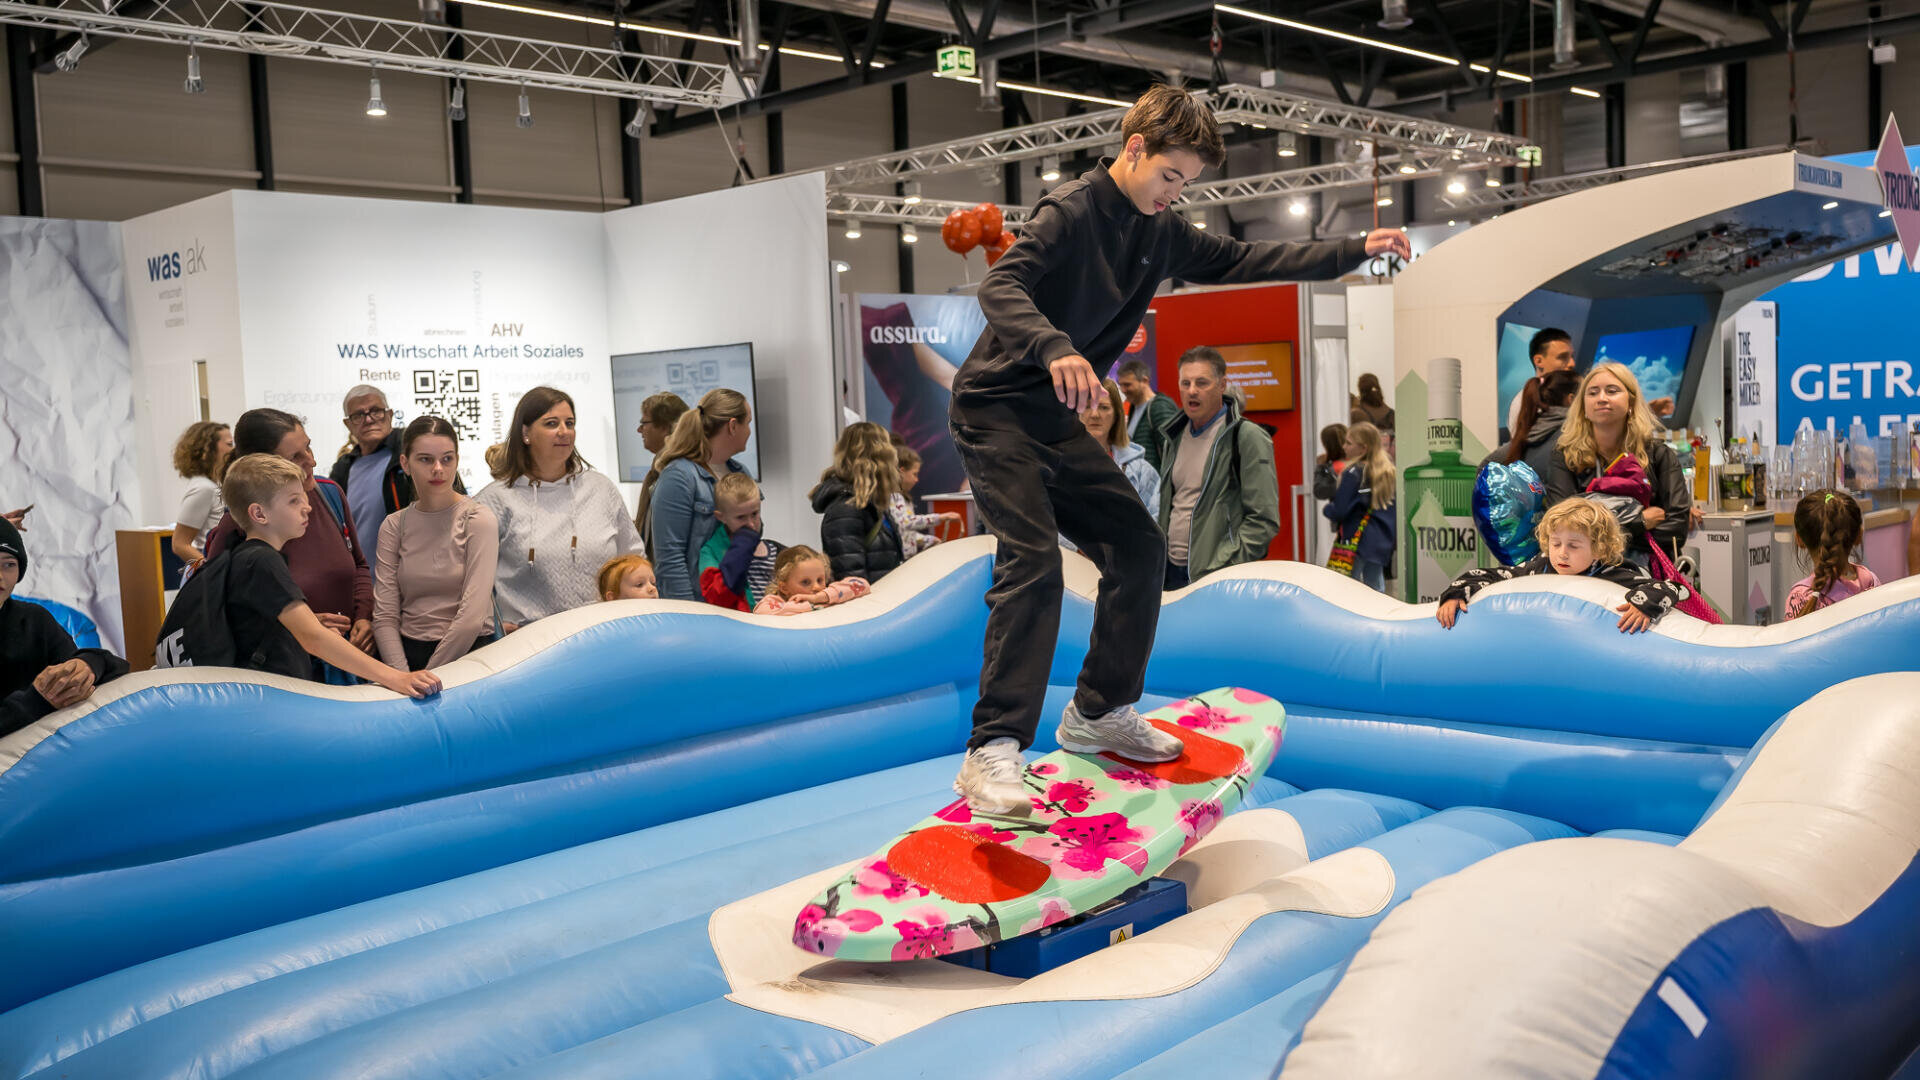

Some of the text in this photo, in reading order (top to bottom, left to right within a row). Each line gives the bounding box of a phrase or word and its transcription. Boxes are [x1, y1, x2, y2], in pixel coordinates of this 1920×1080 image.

[147, 237, 207, 282] was ak
[491, 323, 523, 336] AHV
[337, 344, 584, 358] WAS Wirtschaft Arbeit Soziales
[1738, 331, 1751, 355] THE
[360, 368, 401, 382] Rente
[1739, 357, 1756, 381] EASY
[1790, 360, 1920, 402] GETR
[491, 392, 504, 445] ulagen
